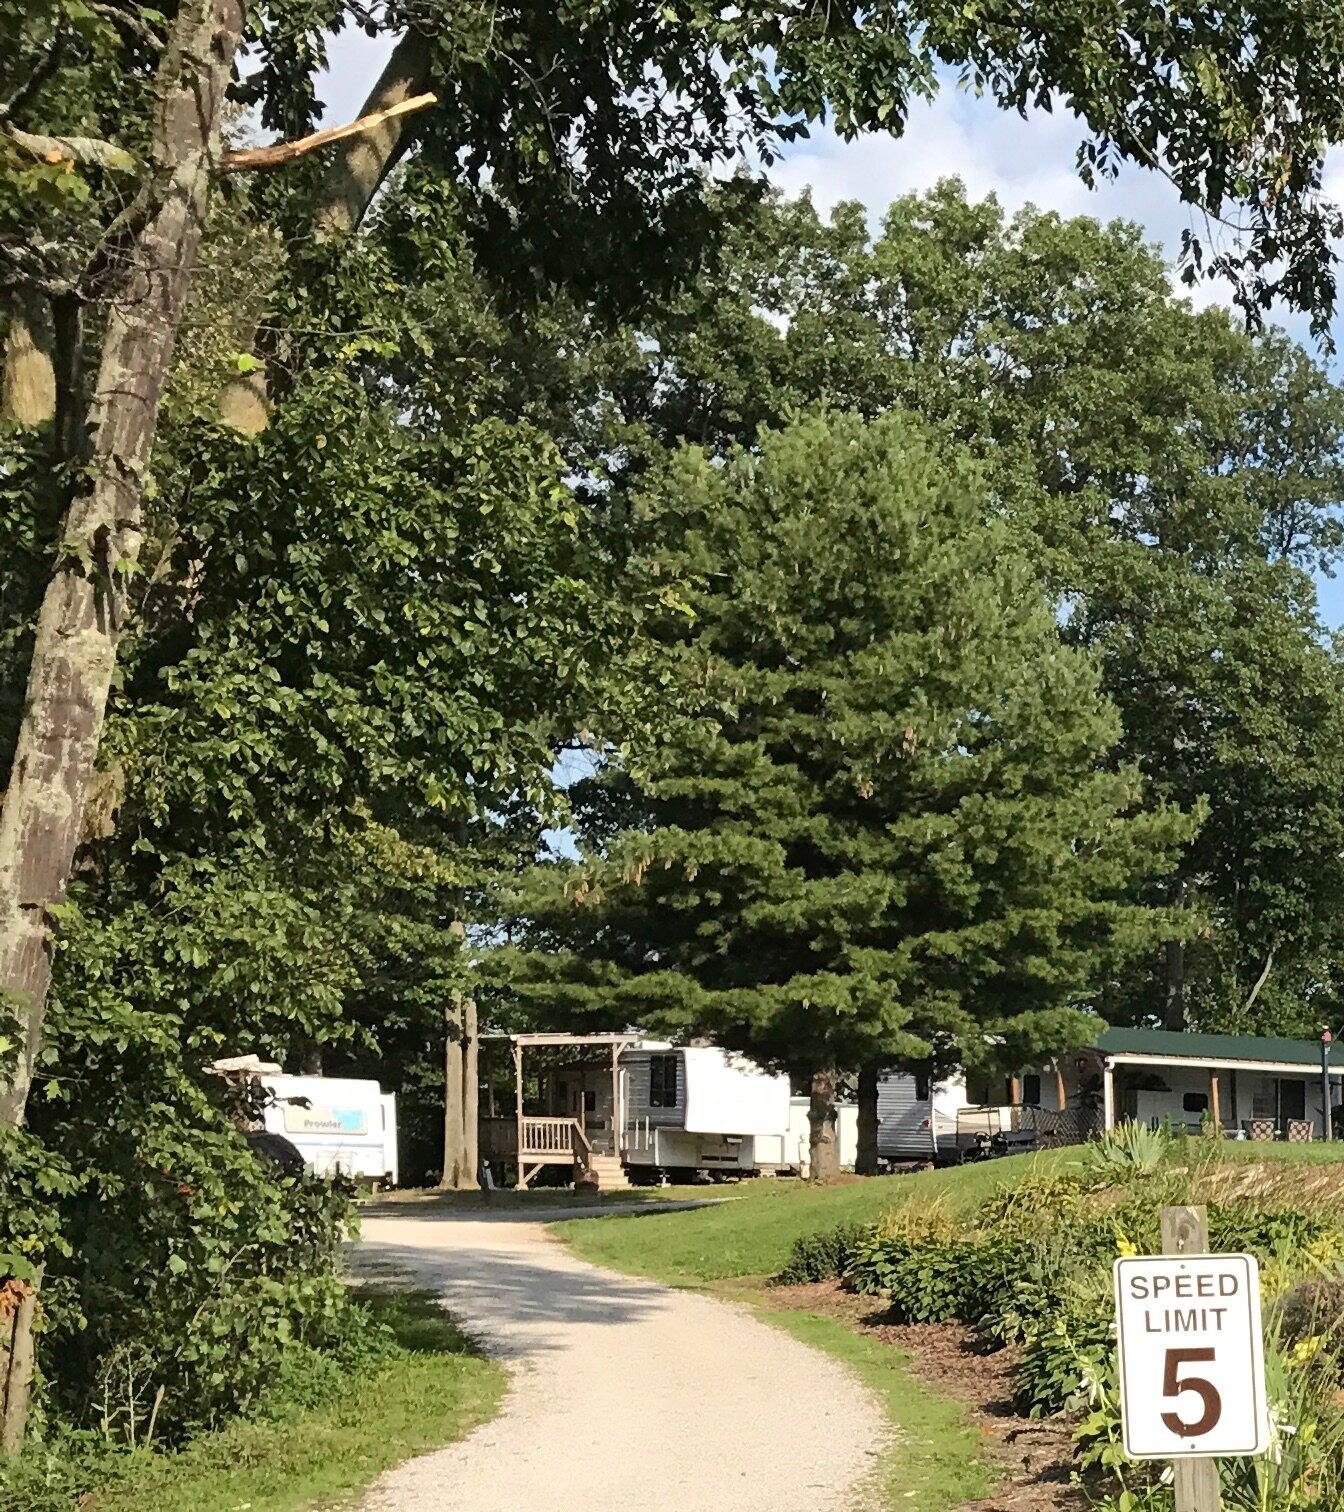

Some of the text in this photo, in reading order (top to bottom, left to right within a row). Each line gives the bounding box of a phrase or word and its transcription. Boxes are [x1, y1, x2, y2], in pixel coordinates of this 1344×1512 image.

[304, 1119, 341, 1129] Prowler
[1130, 1273, 1239, 1299] SPEED
[1144, 1308, 1228, 1333] LIMIT
[1160, 1347, 1222, 1437] 5
